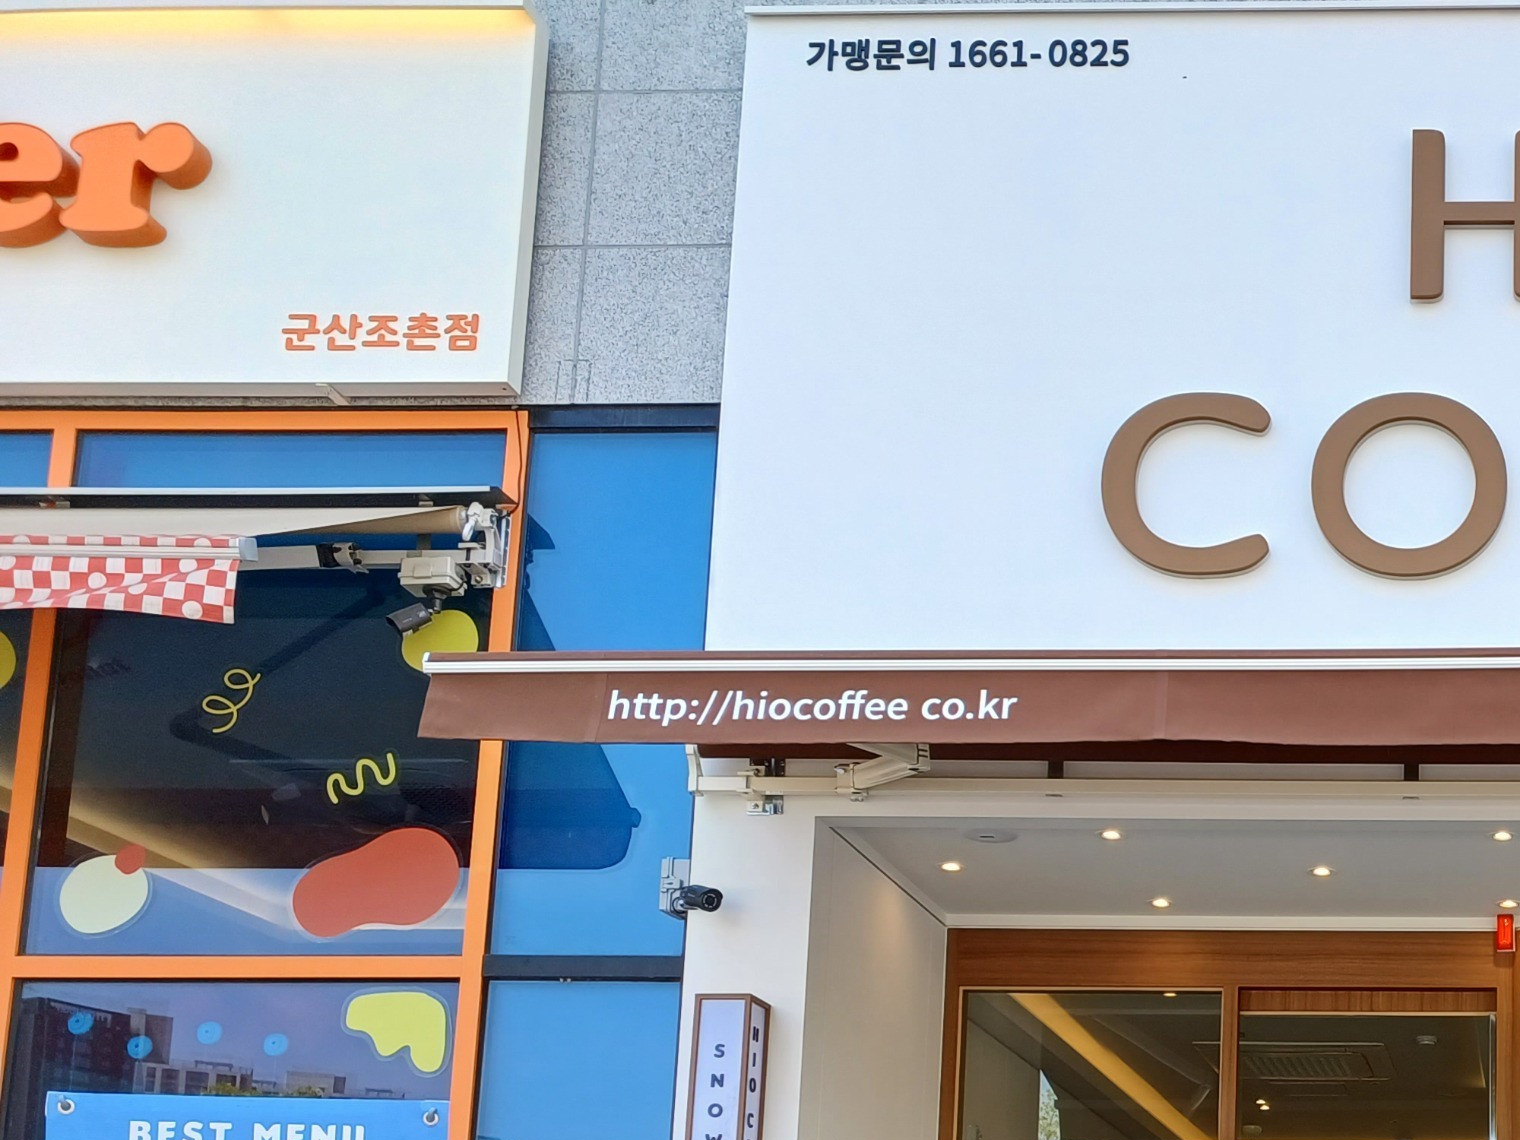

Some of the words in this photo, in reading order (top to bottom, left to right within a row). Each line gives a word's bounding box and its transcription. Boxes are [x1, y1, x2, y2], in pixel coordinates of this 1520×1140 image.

[806, 38, 936, 71] 가맹문의
[948, 39, 1129, 68] 1661-0825
[281, 313, 479, 352] 군산조촌점
[608, 690, 908, 727] http://hiocoffee
[921, 690, 1018, 720] co.kr
[749, 1026, 759, 1093] HIO
